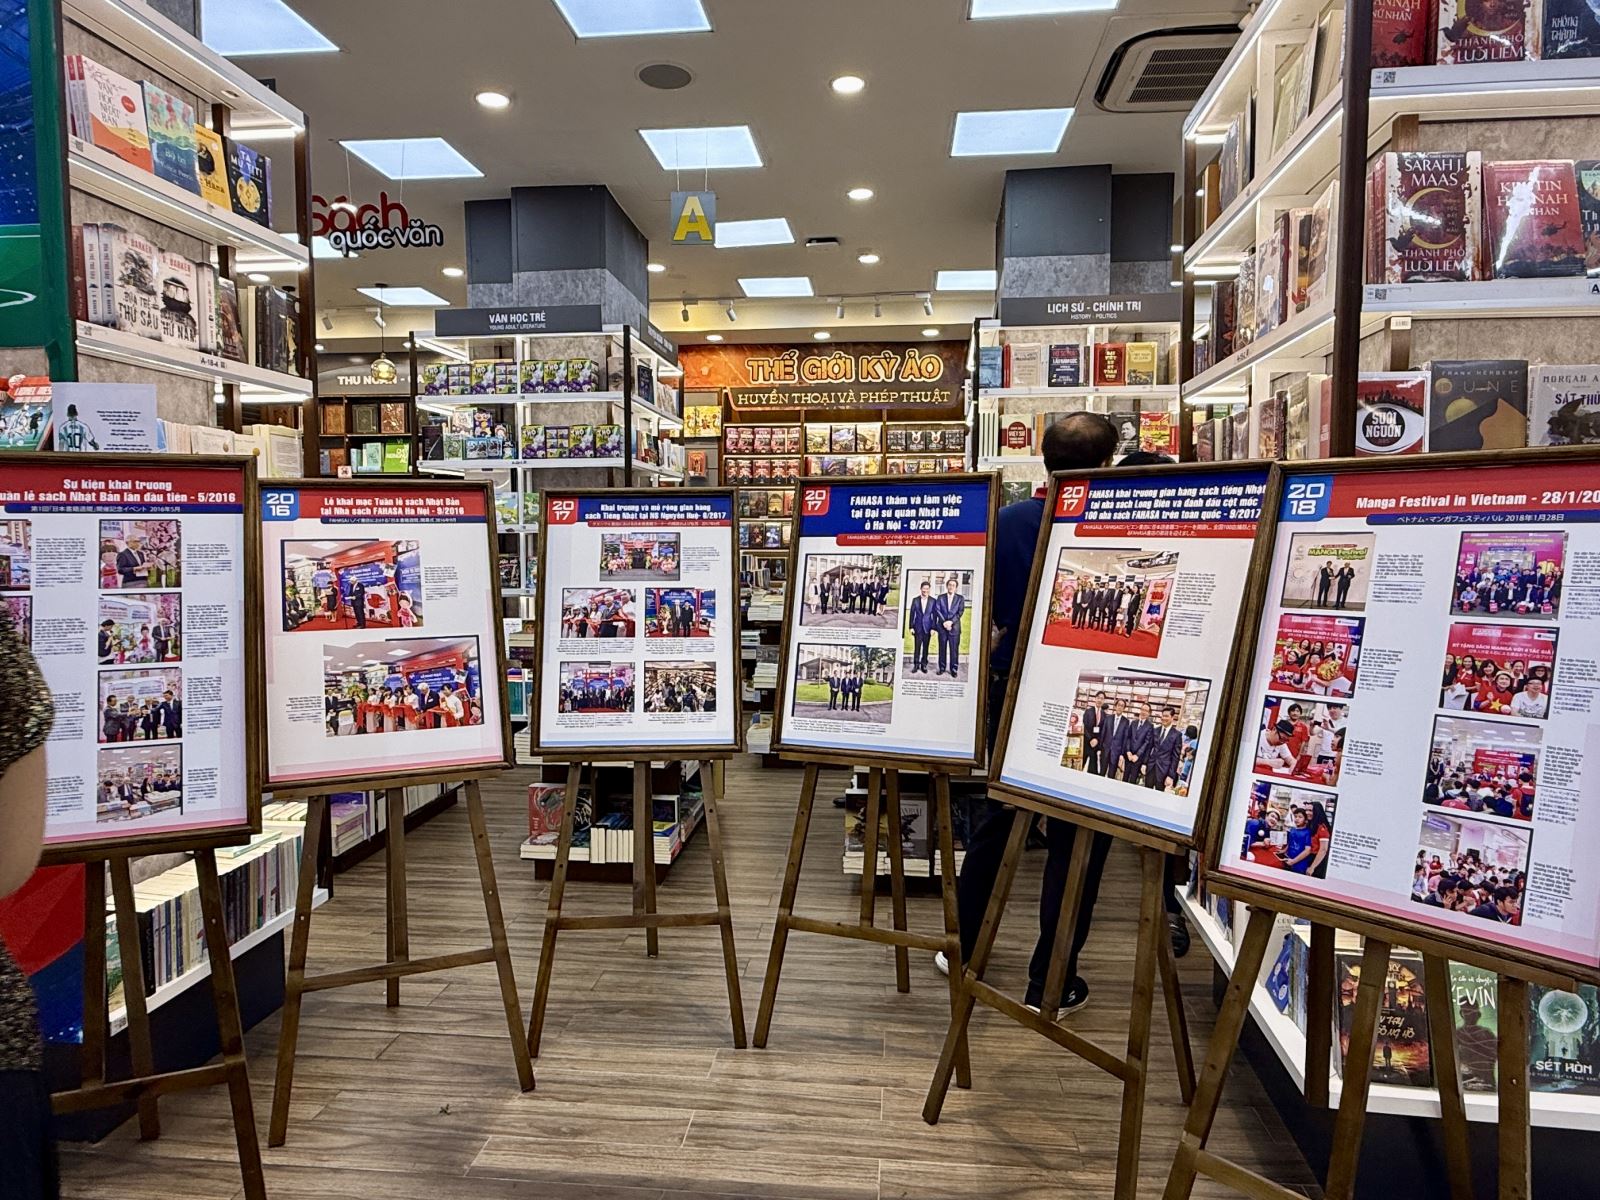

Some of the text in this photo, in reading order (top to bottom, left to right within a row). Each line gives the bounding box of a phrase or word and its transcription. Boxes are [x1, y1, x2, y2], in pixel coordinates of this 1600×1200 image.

[1405, 160, 1464, 173] SARAH J.
[1412, 172, 1458, 186] MAAS
[1498, 194, 1568, 206] HNAH
[673, 196, 712, 240] A
[329, 216, 443, 257] quốc văn
[1047, 304, 1068, 314] LỊCH
[1092, 300, 1124, 312] CHÍNH
[1126, 301, 1142, 312] TRỊ
[510, 313, 528, 324] HỌC
[747, 348, 944, 384] THẾ GIỚI KỲ ẢO
[337, 376, 361, 385] THU
[1544, 375, 1586, 383] MORGAN
[1440, 380, 1518, 392] DUNE
[738, 388, 950, 405] HUYỀN THOẠI VÀ PHÉP THUẬT
[108, 480, 132, 490] khai
[1288, 483, 1326, 498] 20
[0, 490, 20, 501] uần
[198, 492, 236, 502] 5/2016
[805, 490, 826, 500] 20
[1062, 486, 1084, 498] 20
[1088, 490, 1115, 498] FAHASA
[1116, 488, 1132, 498] khai
[1159, 488, 1176, 499] gian
[266, 493, 294, 504] 20
[336, 497, 354, 506] khai
[850, 496, 882, 506] FAHASA
[910, 496, 921, 505] và
[943, 494, 962, 506] việc
[1356, 490, 1600, 510] Manga Festival in Vietnam 28/1/20
[270, 506, 290, 516] 16
[374, 507, 402, 515] FAHASA
[552, 501, 574, 510] 20
[808, 501, 822, 511] 17
[1062, 500, 1079, 512] 17
[1134, 500, 1151, 510] Long
[1290, 500, 1316, 515] 18
[554, 512, 570, 520] 17
[851, 508, 863, 519] tại
[942, 506, 960, 517] Bản
[1084, 511, 1098, 520] 100
[1132, 510, 1160, 520] FAHASA
[1230, 510, 1261, 519] 9/2017
[1506, 513, 1564, 522] 2018年1月28日
[872, 520, 944, 531] Hà Nội 9/2017
[1536, 1058, 1592, 1074] SÉT HÒN
